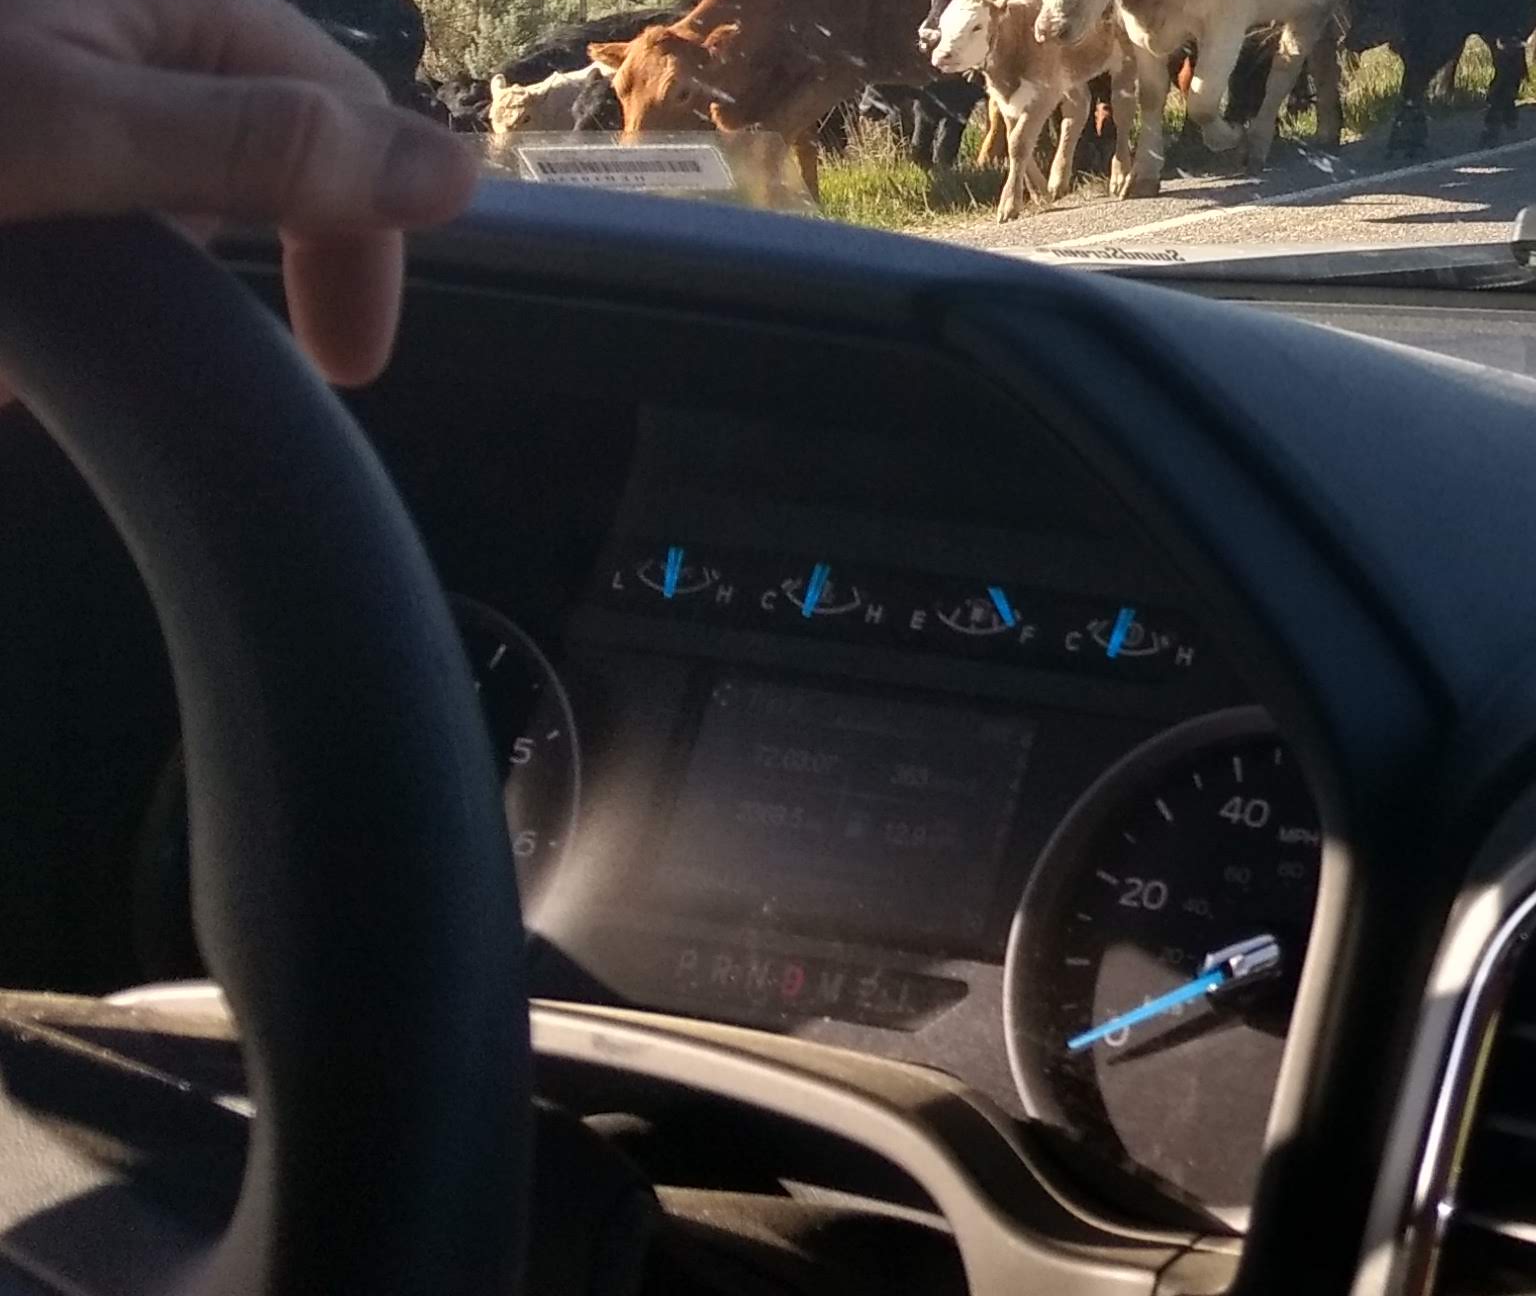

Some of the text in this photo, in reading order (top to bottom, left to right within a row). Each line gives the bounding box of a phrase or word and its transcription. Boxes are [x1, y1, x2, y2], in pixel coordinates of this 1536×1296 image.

[611, 571, 625, 589] L
[716, 584, 734, 604] H
[761, 591, 778, 610] C
[865, 604, 884, 624] H
[909, 610, 926, 630] E
[1019, 626, 1035, 644] F
[1065, 631, 1082, 651] C
[1175, 646, 1195, 666] H
[509, 737, 535, 765] 5
[1218, 795, 1272, 829] 40
[512, 830, 537, 857] 6
[1118, 877, 1169, 910] 20
